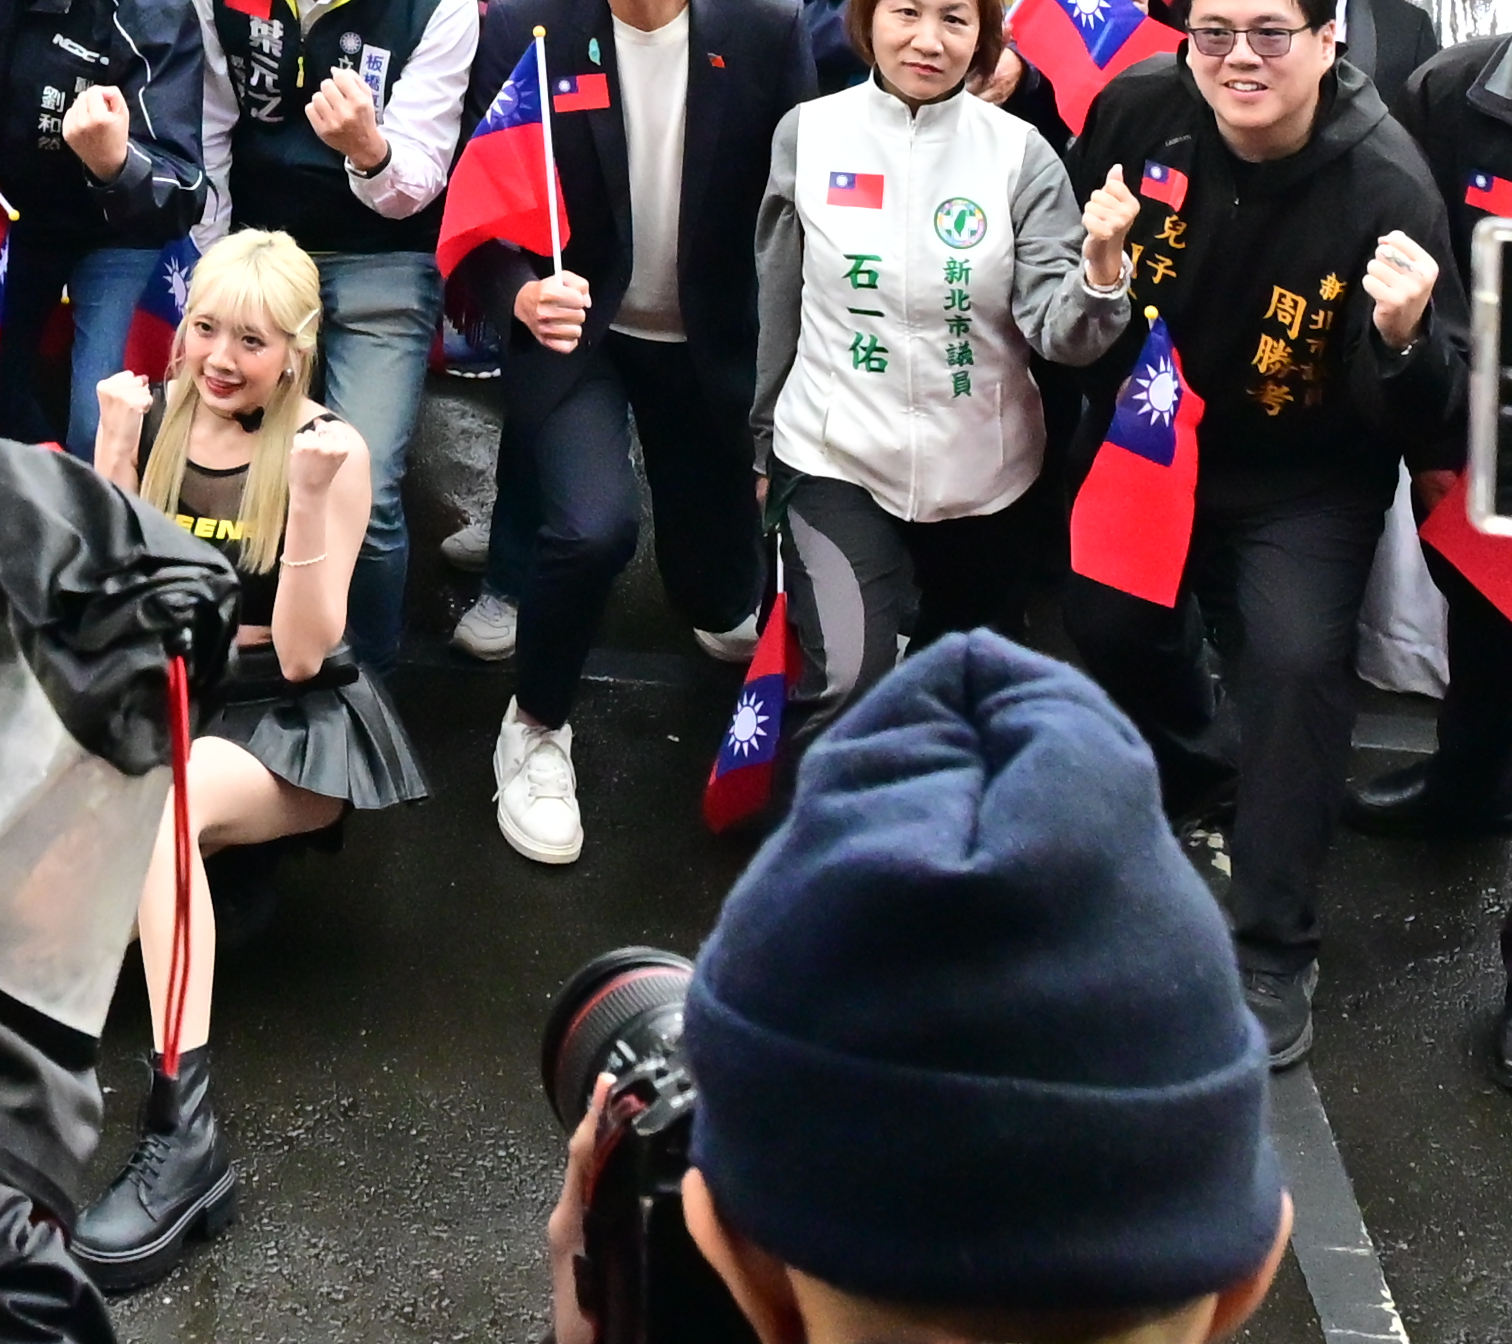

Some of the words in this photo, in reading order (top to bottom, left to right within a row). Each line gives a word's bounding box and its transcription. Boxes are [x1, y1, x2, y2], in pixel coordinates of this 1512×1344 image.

[1145, 215, 1187, 284] 兒子
[842, 253, 890, 374] 石一佑
[942, 256, 974, 399] 新北市議員
